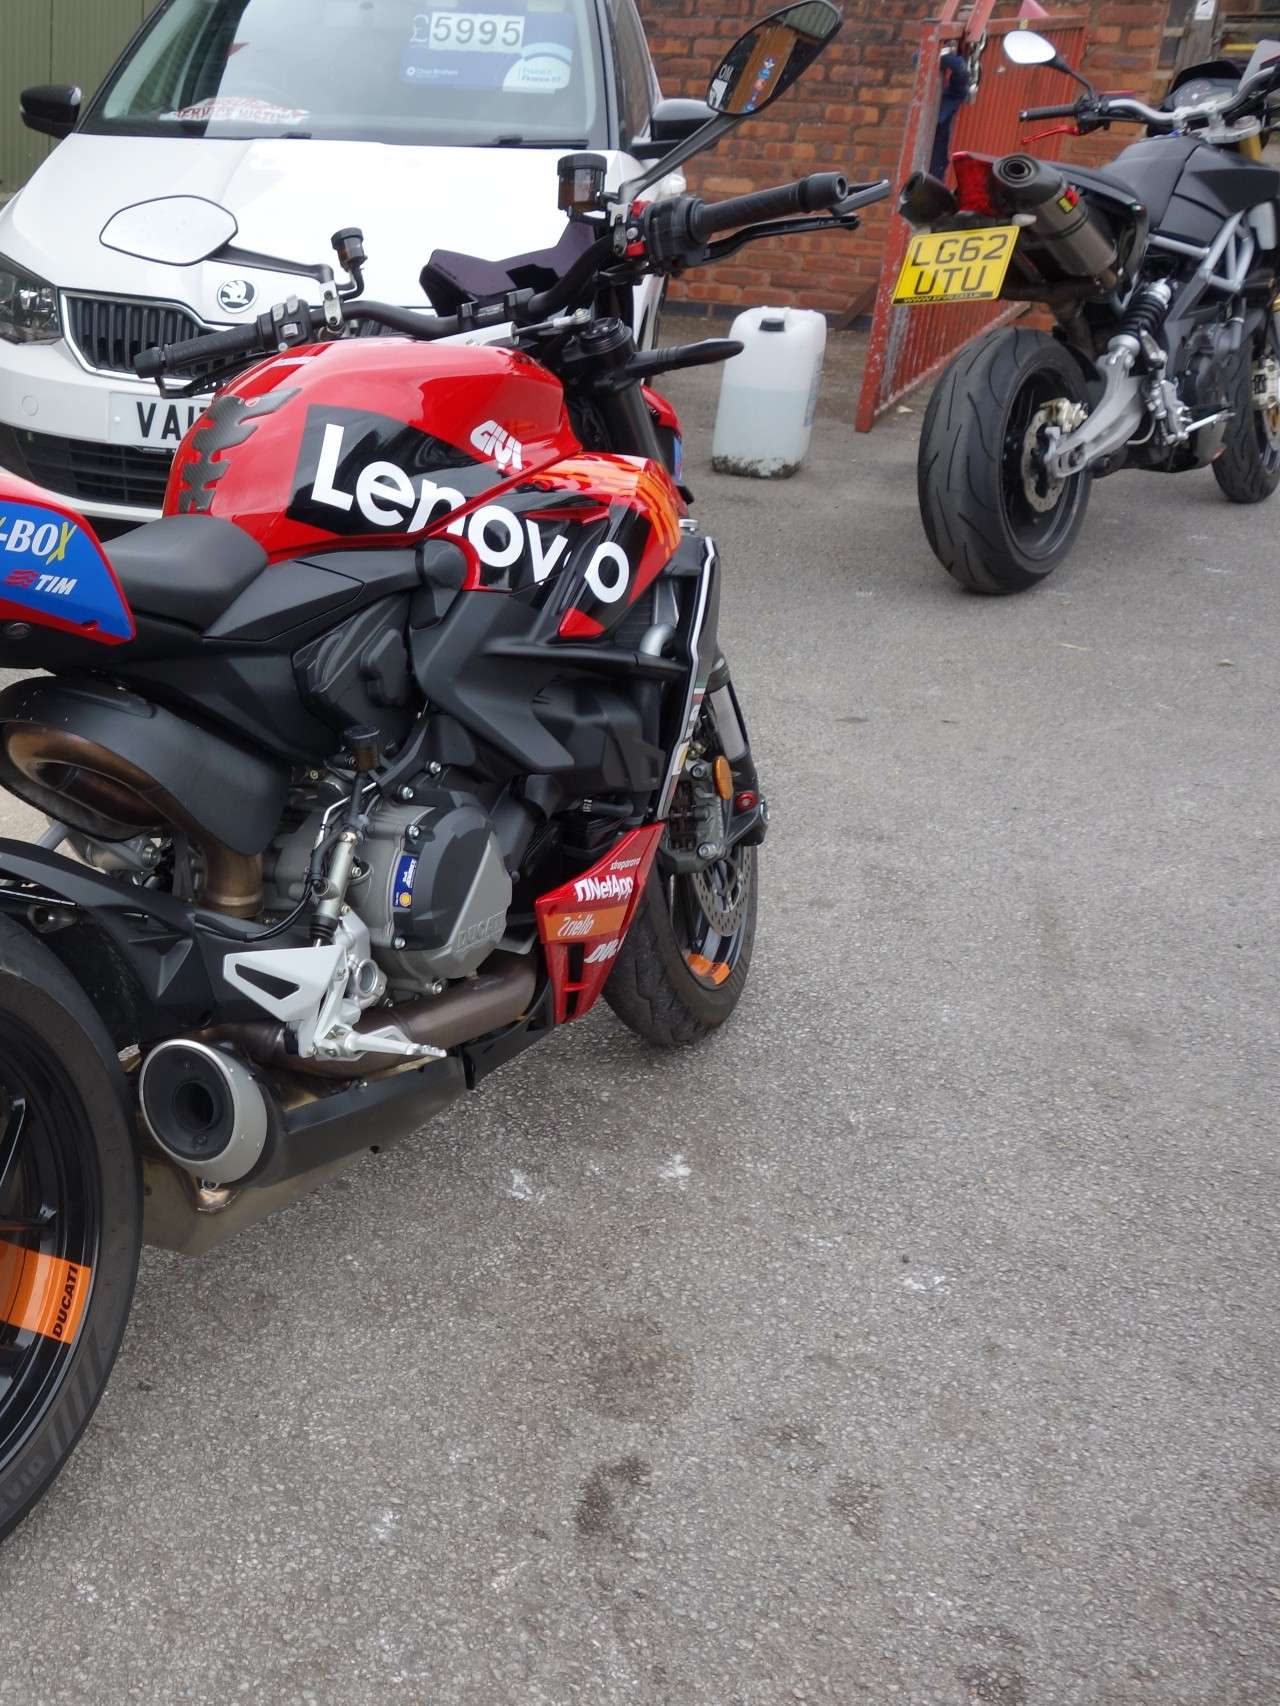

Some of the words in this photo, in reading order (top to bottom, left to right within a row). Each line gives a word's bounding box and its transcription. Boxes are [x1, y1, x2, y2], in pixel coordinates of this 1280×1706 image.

[911, 234, 1008, 266] LG62
[914, 265, 987, 295] UTU
[311, 423, 629, 604] Lenovo
[34, 574, 77, 595] TIM
[589, 874, 635, 901] NetApp
[52, 1264, 78, 1338] DUCATI
